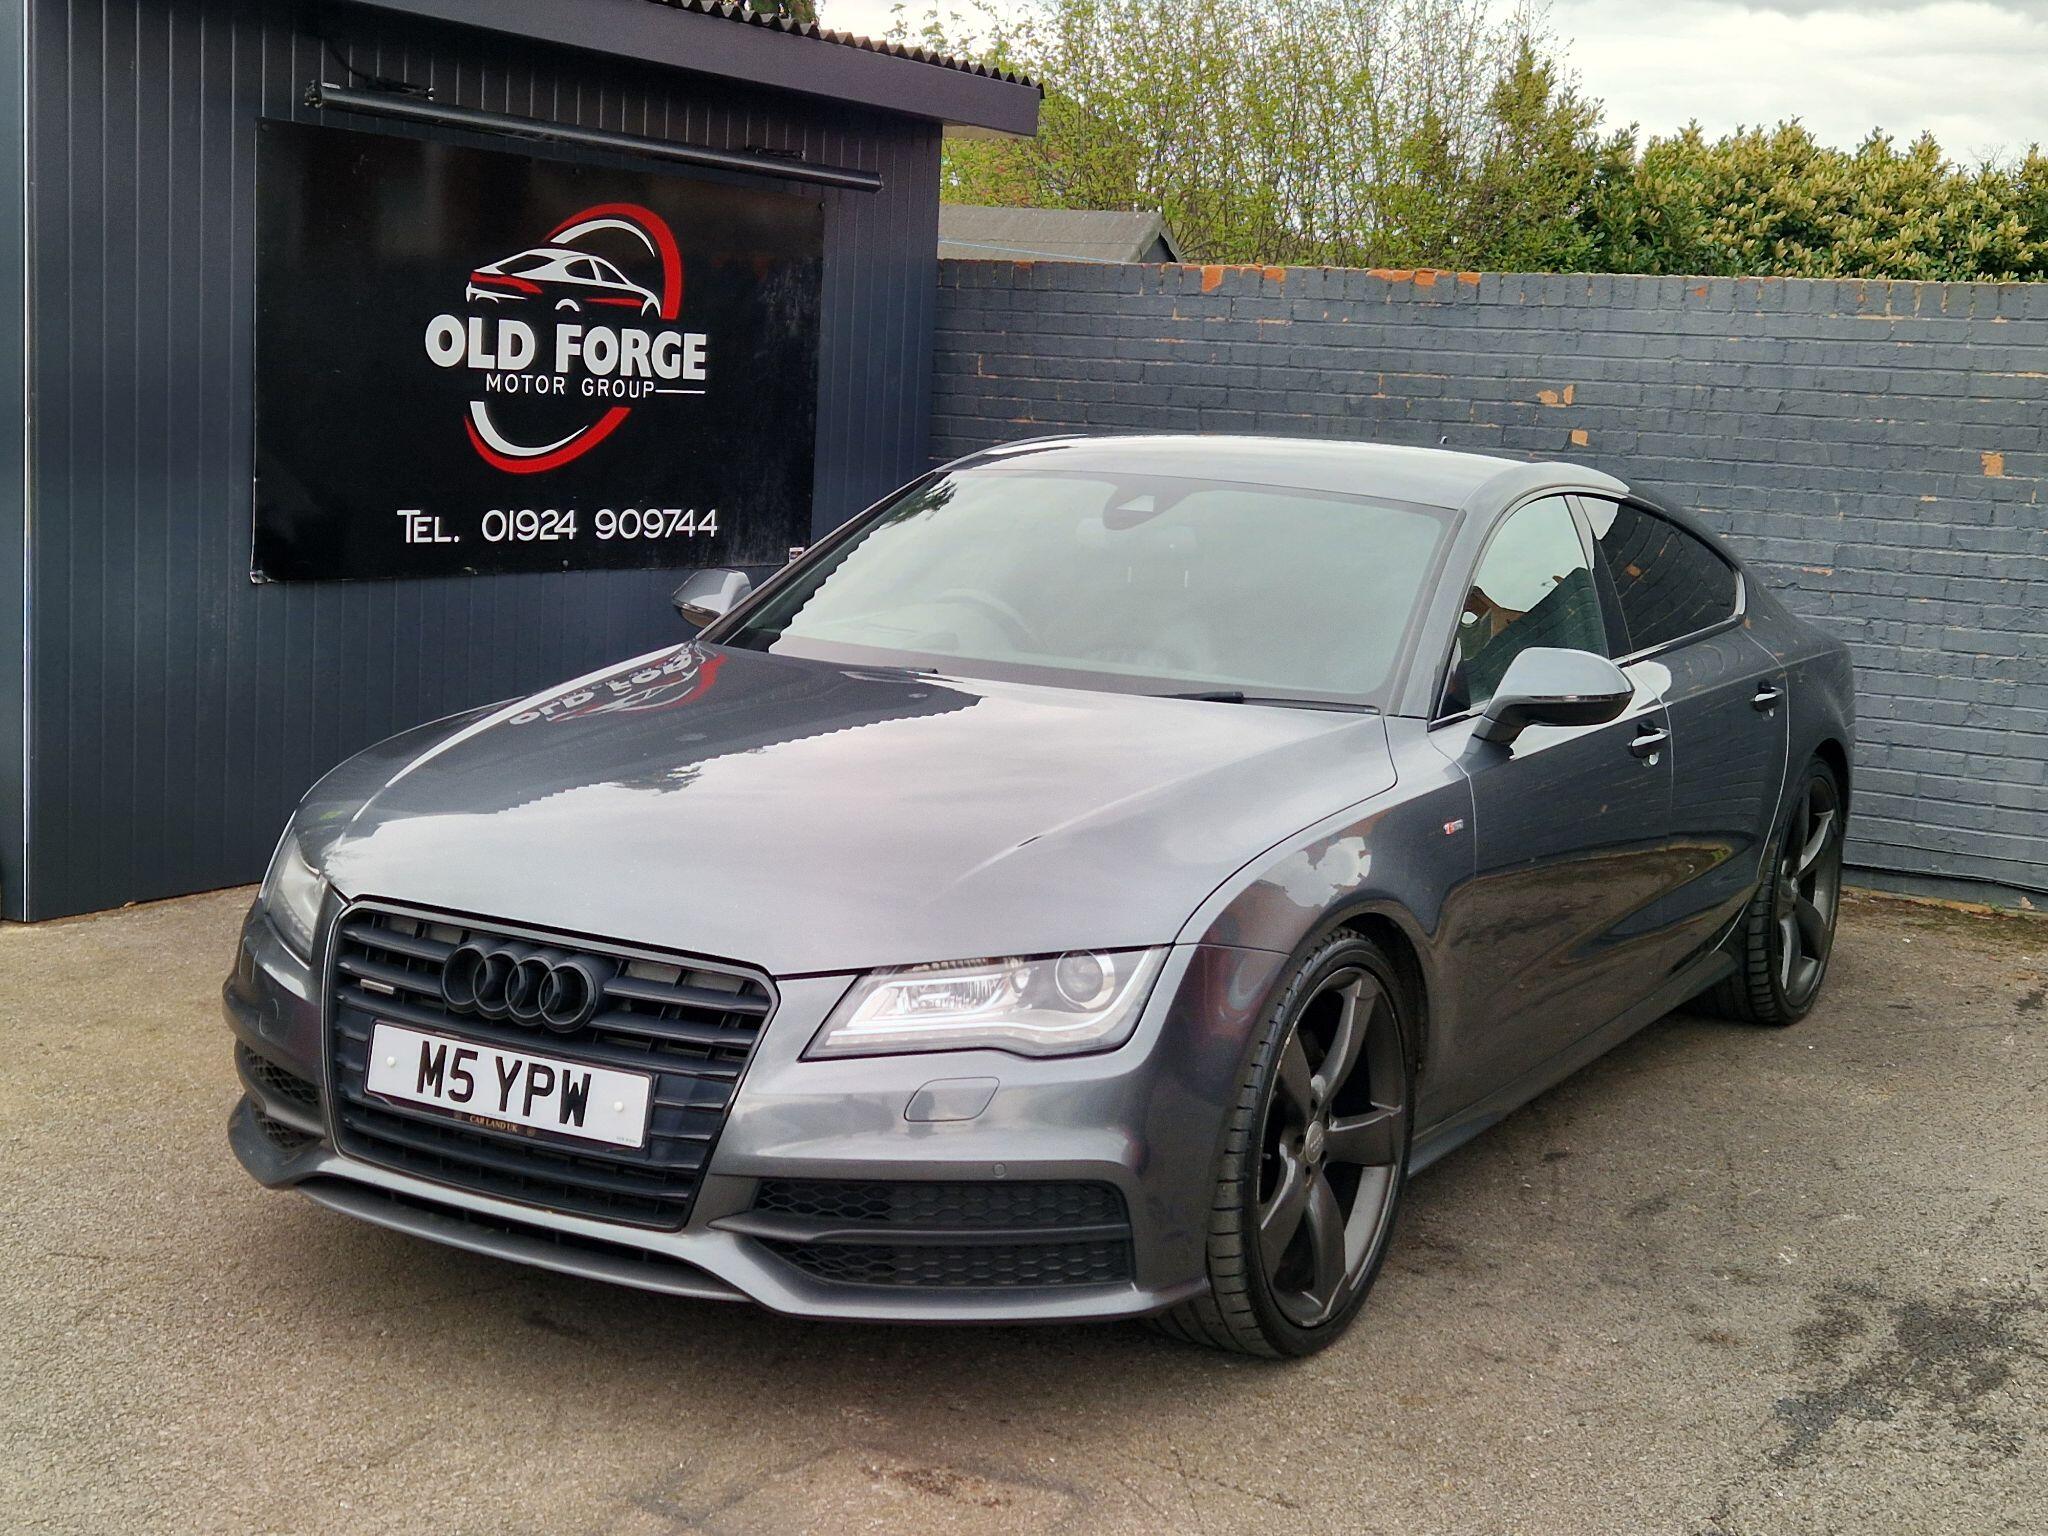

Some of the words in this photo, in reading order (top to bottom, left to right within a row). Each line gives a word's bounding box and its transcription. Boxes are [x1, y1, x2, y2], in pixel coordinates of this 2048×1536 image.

[424, 314, 536, 371] OLD
[555, 323, 707, 381] FORGE
[486, 373, 566, 395] MOTOR
[581, 377, 655, 399] GROUP
[397, 509, 460, 544] TEL.
[481, 509, 578, 542] 01924
[594, 508, 718, 541] 909744
[416, 1040, 479, 1104] M5
[495, 1055, 592, 1128] YPW
